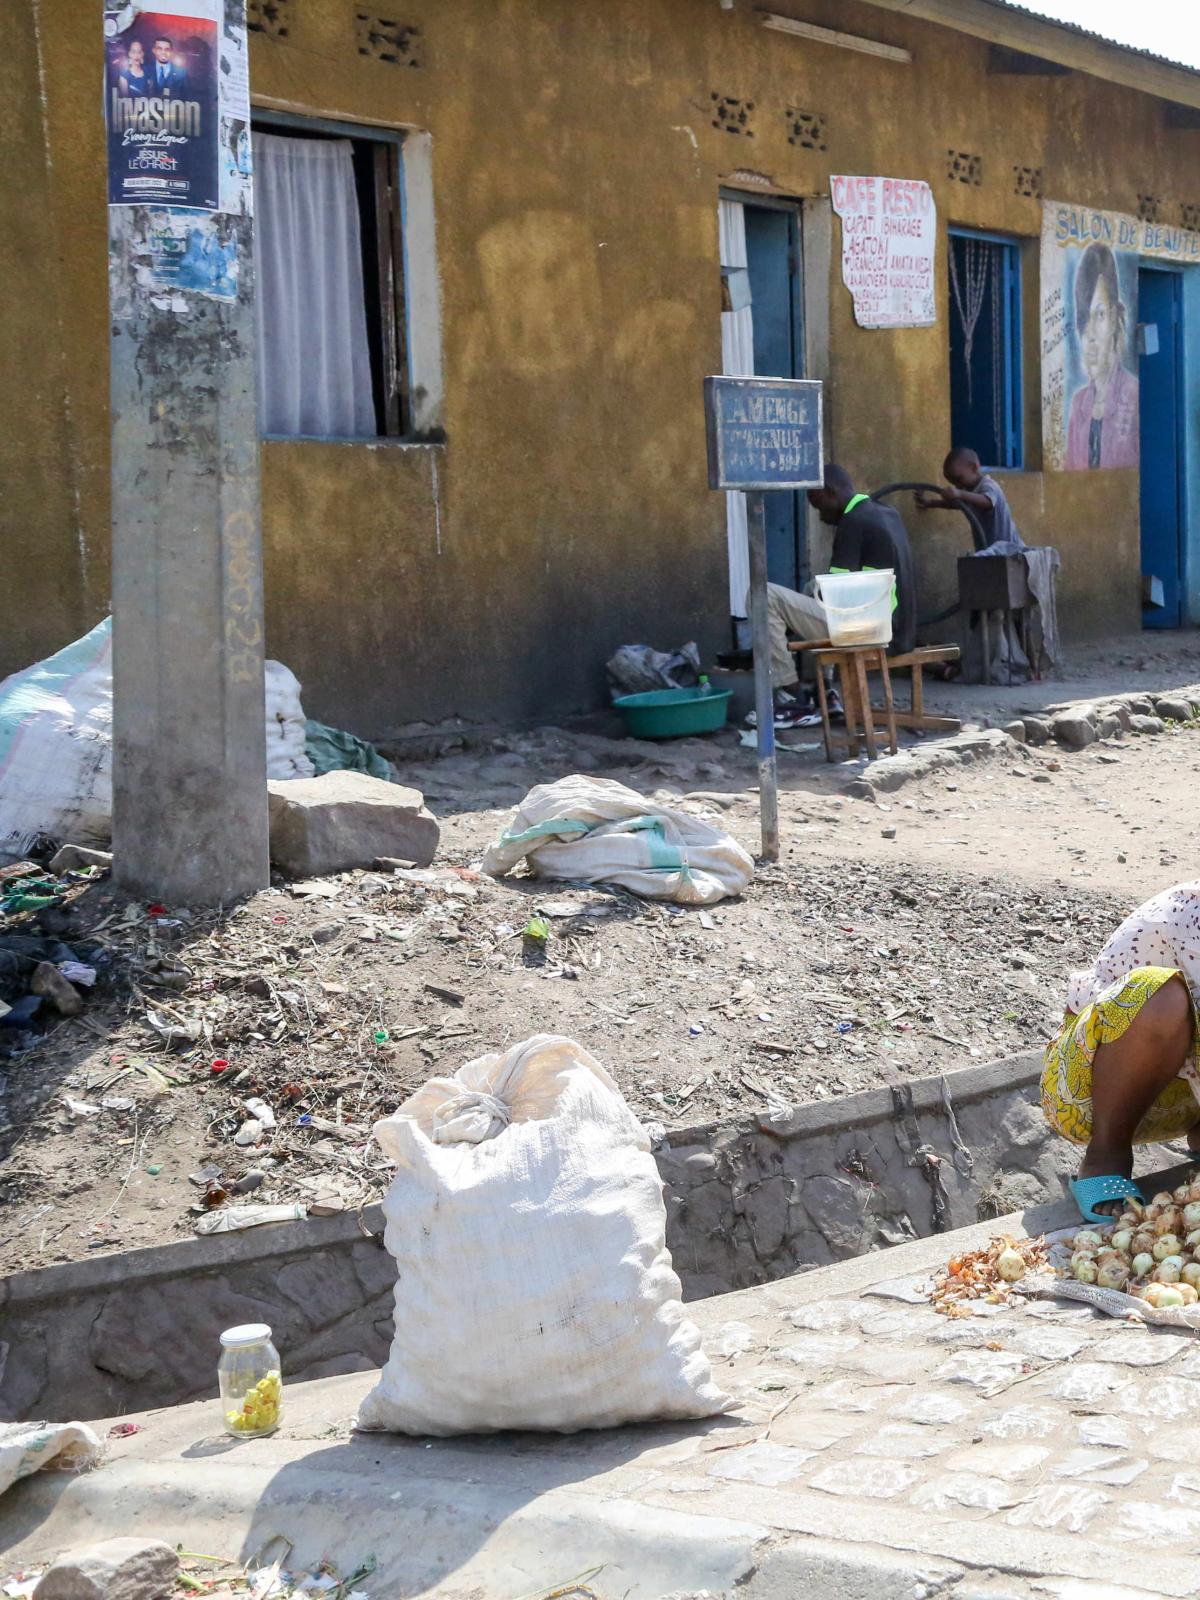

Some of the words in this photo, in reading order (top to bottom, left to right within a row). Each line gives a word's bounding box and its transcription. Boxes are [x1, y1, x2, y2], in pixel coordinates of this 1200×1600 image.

[112, 87, 200, 137] Invasion
[128, 159, 139, 169] LE
[139, 158, 178, 171] CHRIST
[832, 177, 876, 215] CAFE
[882, 179, 931, 216] RESTO
[1056, 208, 1112, 240] SALON
[1144, 223, 1199, 255] BEAUTE
